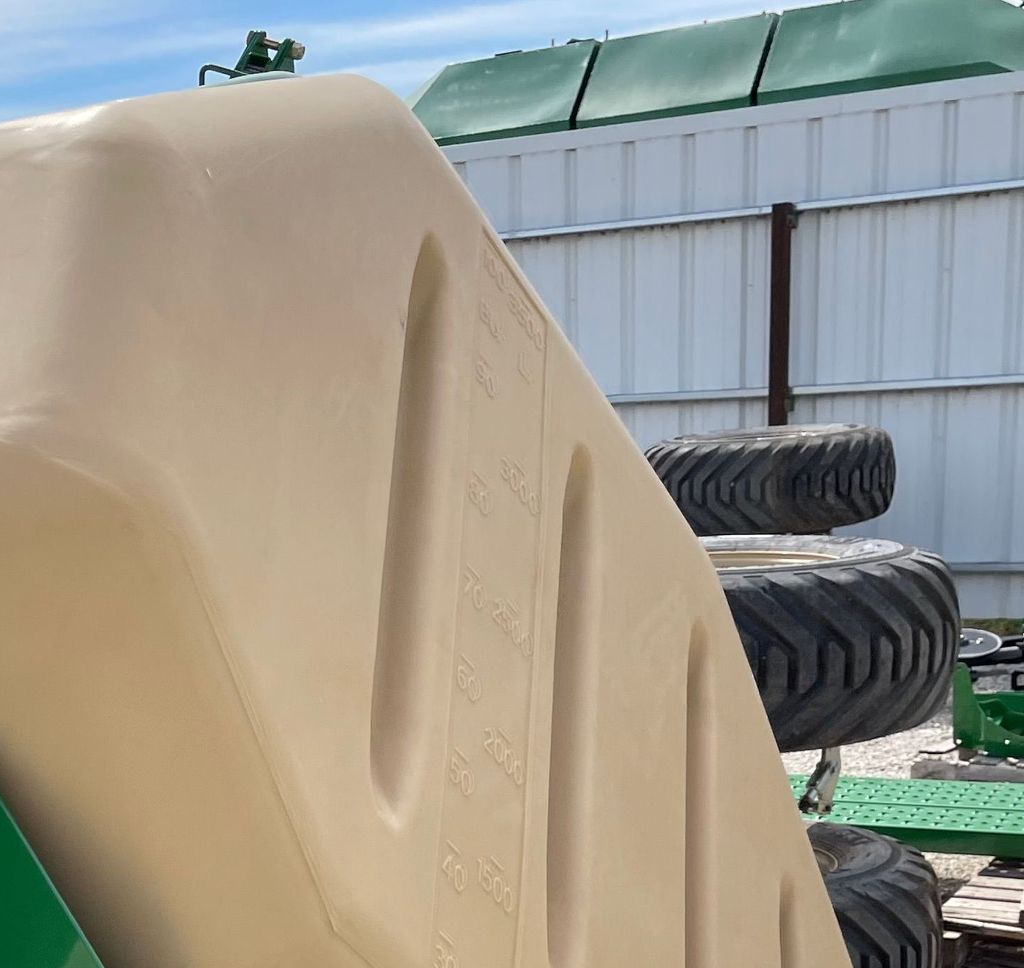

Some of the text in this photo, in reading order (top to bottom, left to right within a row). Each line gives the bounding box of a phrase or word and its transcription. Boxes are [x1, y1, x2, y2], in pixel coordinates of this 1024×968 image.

[463, 571, 488, 609] 70
[457, 665, 482, 702] 60
[449, 755, 476, 796] 50
[483, 727, 524, 786] 2000
[441, 855, 469, 893] 40
[476, 855, 514, 913] 1500
